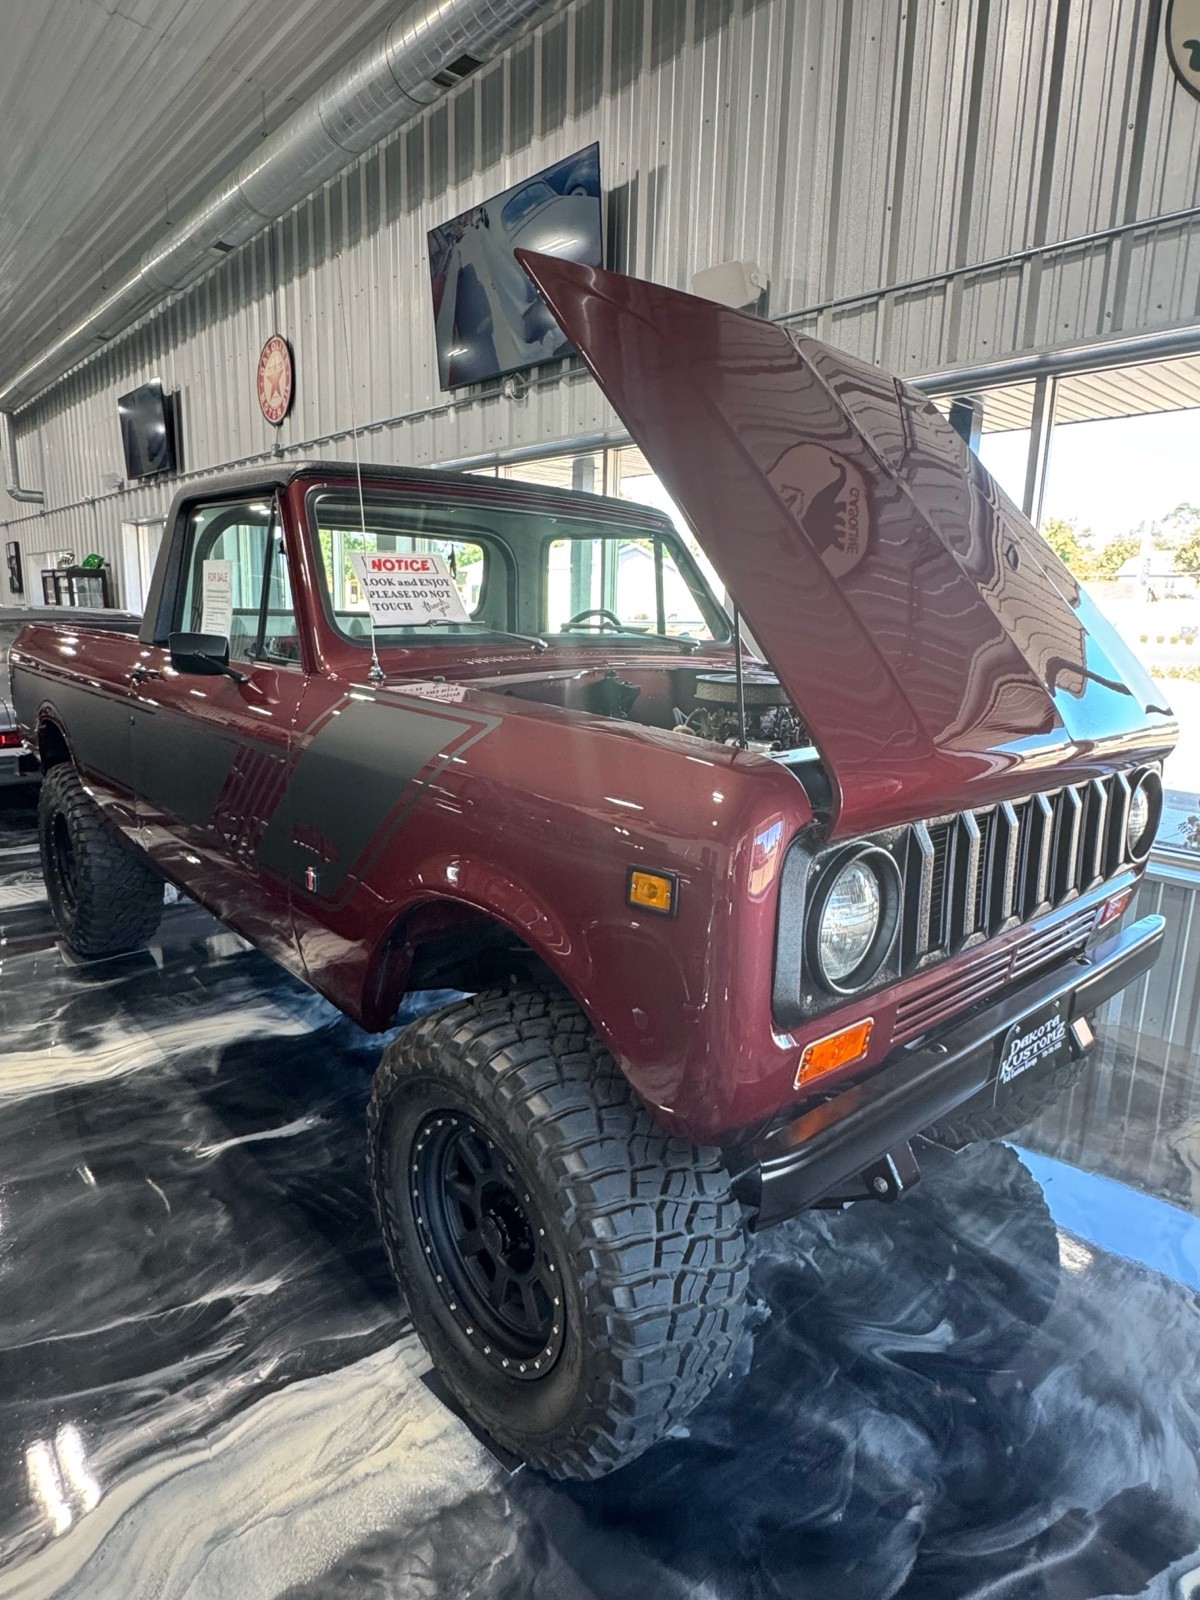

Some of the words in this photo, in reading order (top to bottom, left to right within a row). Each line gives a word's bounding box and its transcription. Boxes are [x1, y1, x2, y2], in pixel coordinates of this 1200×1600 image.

[371, 558, 430, 572] NOTICE
[207, 572, 216, 582] FOR
[217, 572, 228, 582] SALE
[363, 577, 396, 587] LOOK
[397, 577, 418, 587] and
[419, 578, 451, 589] ENJOY
[369, 590, 411, 599] PLEASE
[411, 590, 428, 599] DO
[430, 590, 451, 598] NOT
[372, 602, 414, 611] TOUCH
